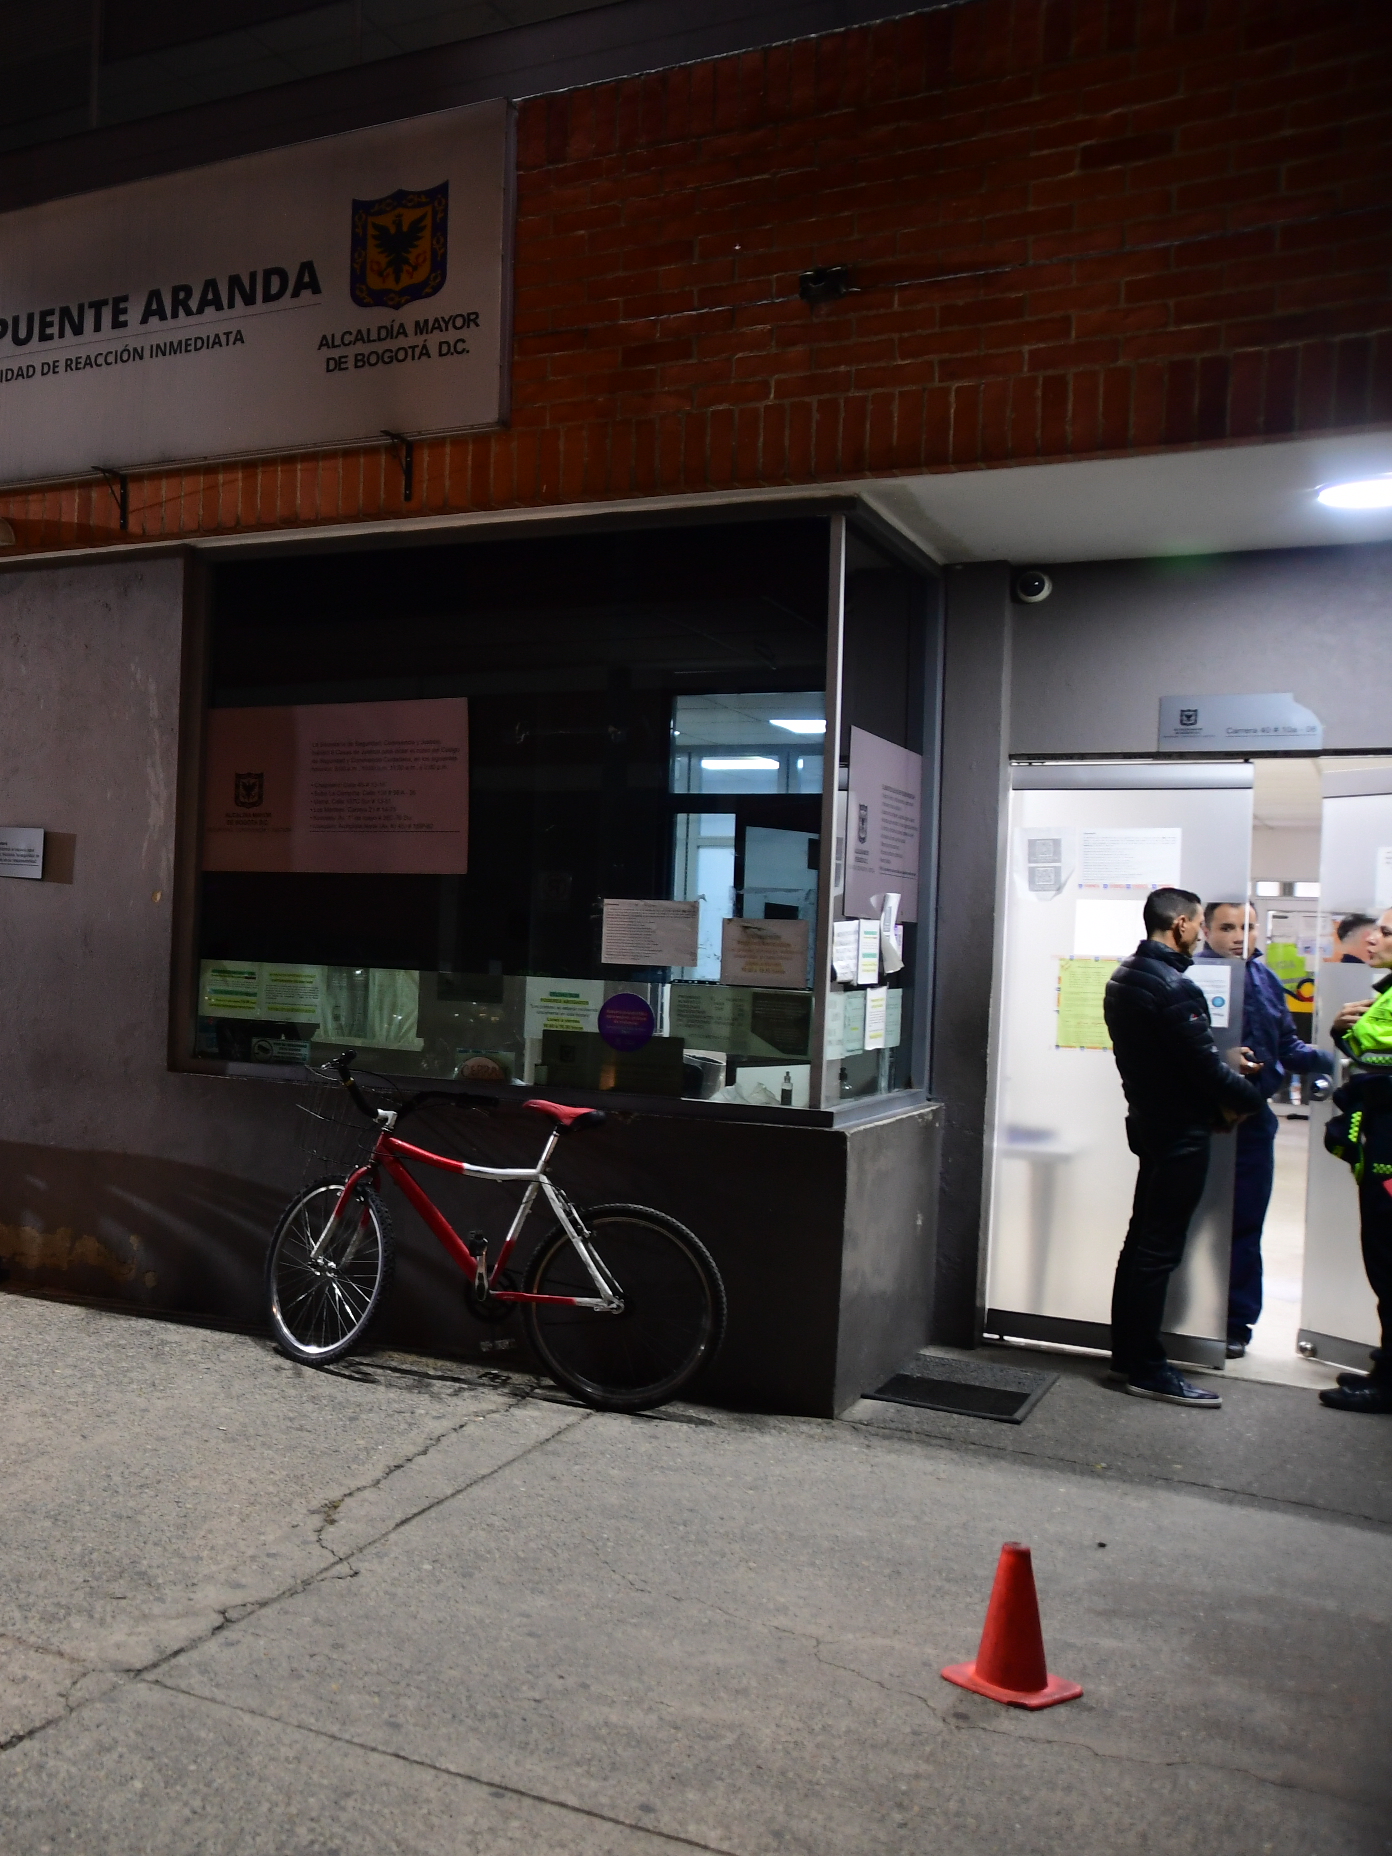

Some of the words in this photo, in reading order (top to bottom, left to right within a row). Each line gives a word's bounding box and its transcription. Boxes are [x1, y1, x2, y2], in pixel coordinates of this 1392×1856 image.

[140, 260, 322, 325] ARANDA
[317, 319, 408, 350] ALCALDÍA
[414, 311, 480, 336] MAYOR
[41, 359, 60, 376] DE
[64, 343, 145, 372] REACCIÓN
[149, 329, 245, 359] INMEDIATA
[326, 355, 349, 372] DE
[354, 339, 431, 368] BOGOTÁ
[438, 338, 470, 357] D.C.
[1226, 727, 1258, 735] Carrera
